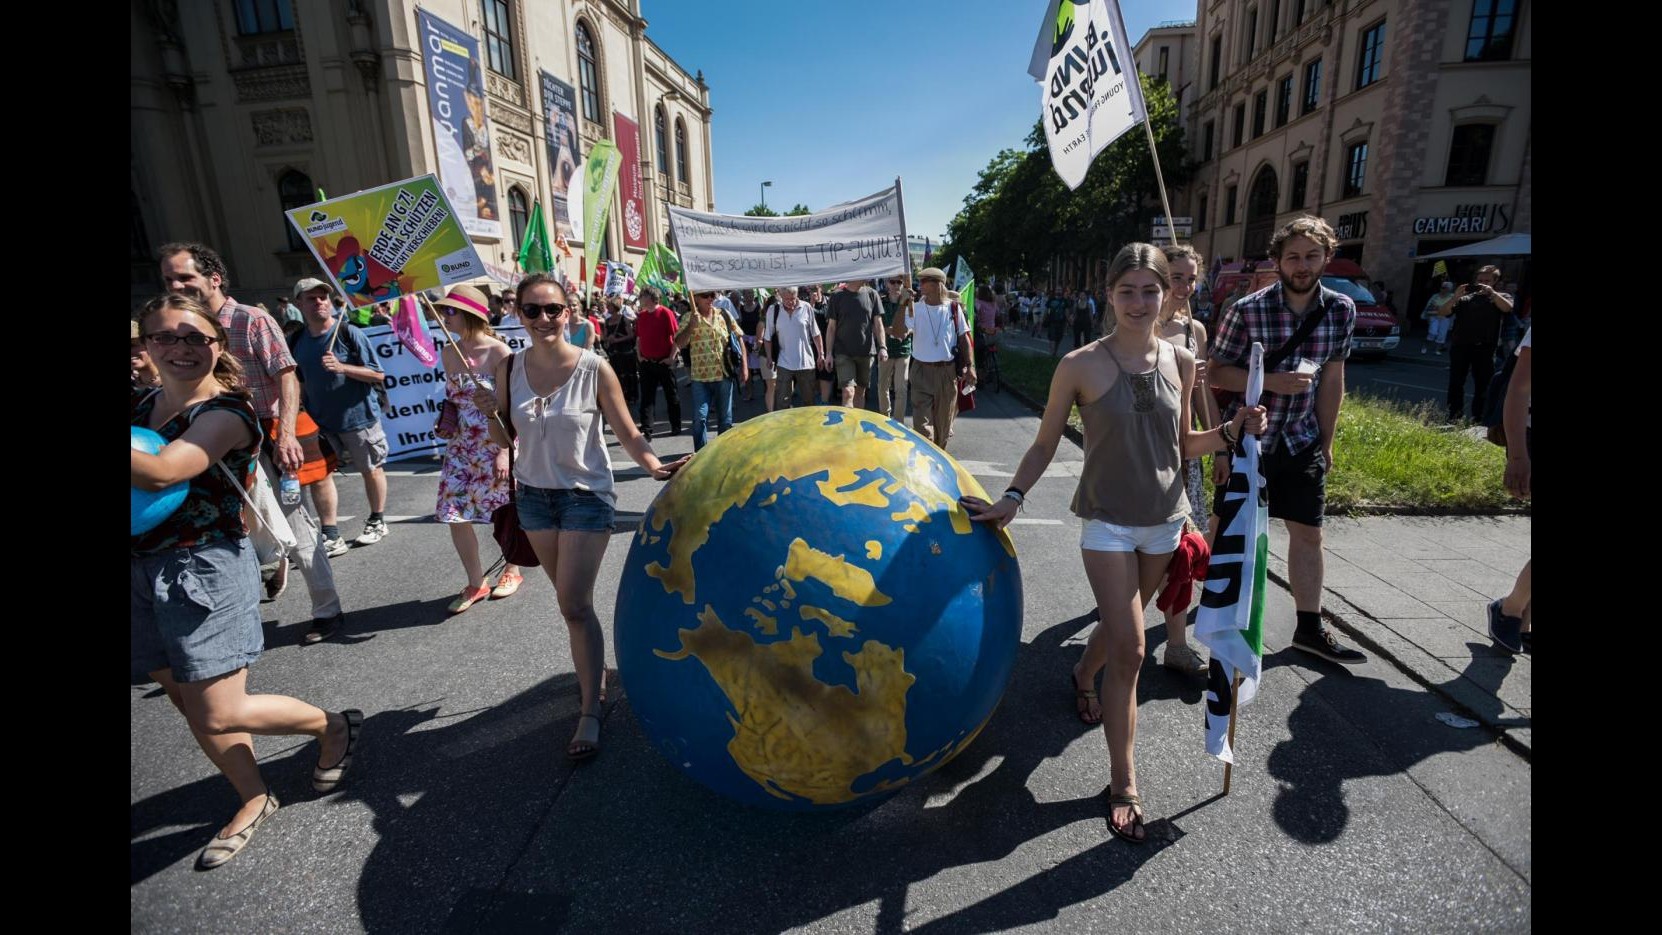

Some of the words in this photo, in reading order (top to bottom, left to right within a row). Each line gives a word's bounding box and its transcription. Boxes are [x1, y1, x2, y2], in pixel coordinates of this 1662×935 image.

[426, 20, 458, 164] Myanmar
[381, 236, 408, 269] KLIMA
[403, 191, 438, 239] SCHÜTZEN
[784, 218, 811, 232] nicht
[816, 218, 829, 227] so
[1335, 224, 1353, 239] PARI
[1413, 216, 1487, 234] CAMPARI
[370, 231, 389, 261] ERDE
[384, 214, 402, 234] AN
[391, 250, 412, 273] NICHT
[407, 208, 448, 255] VERSCHIEBEN!
[450, 261, 471, 271] BUND
[686, 256, 706, 272] wie
[708, 259, 725, 273] es
[728, 252, 766, 271] schon
[383, 368, 446, 389] Demok
[1199, 432, 1250, 608] UND
